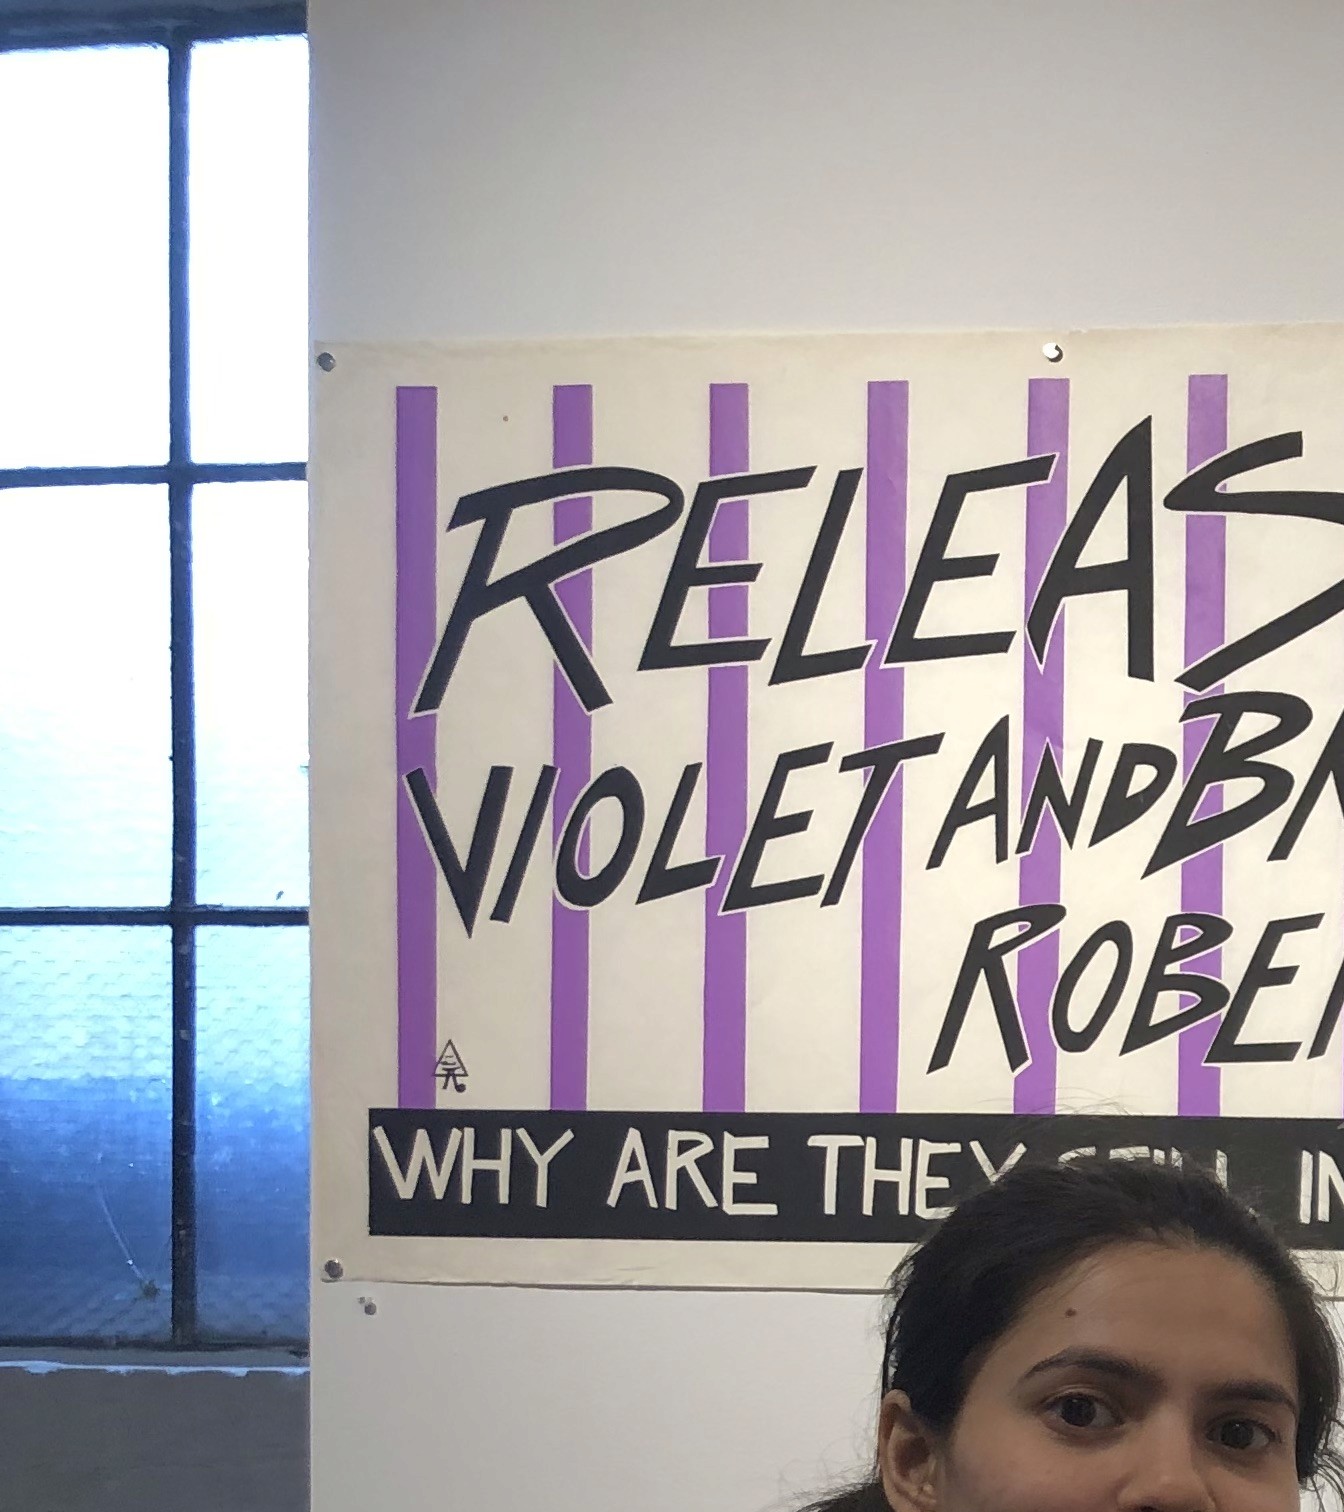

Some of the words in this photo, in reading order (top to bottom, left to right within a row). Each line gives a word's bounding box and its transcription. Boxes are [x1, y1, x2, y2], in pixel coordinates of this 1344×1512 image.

[405, 734, 942, 937] VIOLET
[927, 713, 1179, 871] AND
[373, 1126, 574, 1208] WHY
[606, 1127, 778, 1215] ARE
